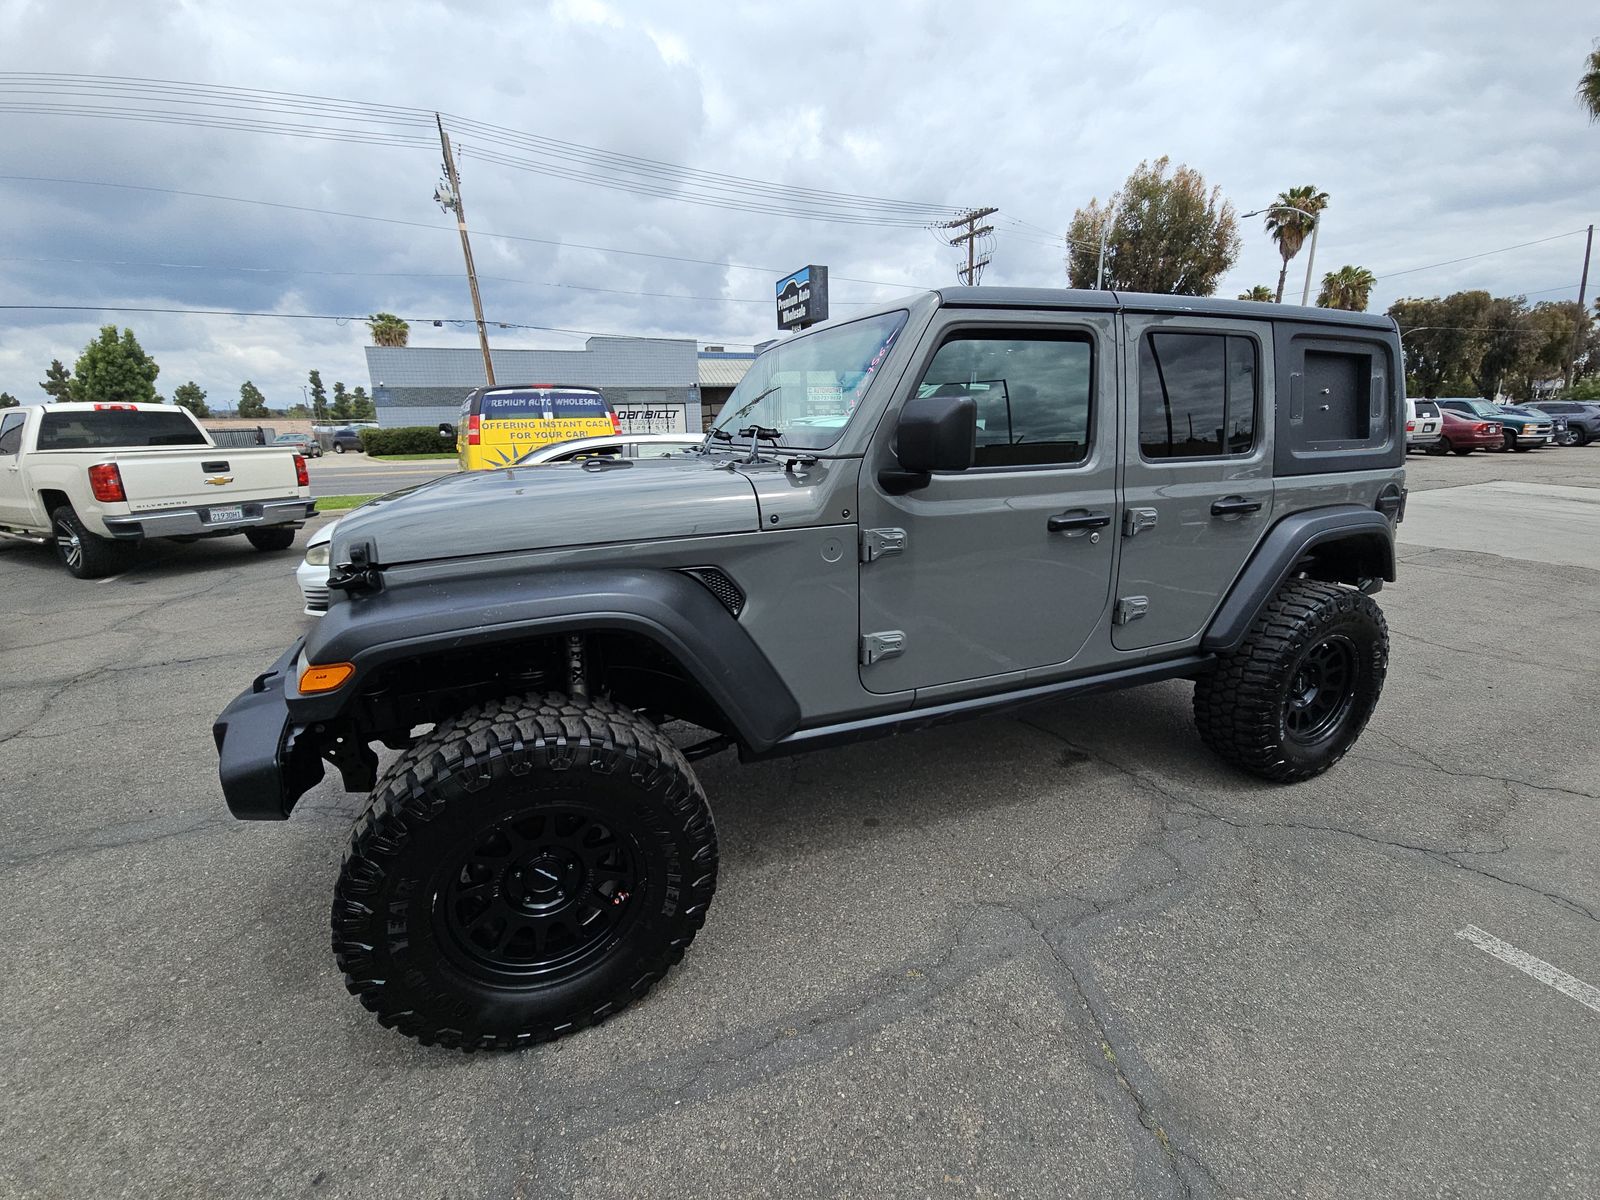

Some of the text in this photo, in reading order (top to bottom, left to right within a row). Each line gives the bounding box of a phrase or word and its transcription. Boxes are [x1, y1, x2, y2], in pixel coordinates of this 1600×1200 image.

[778, 288, 810, 311] Premium Auto
[783, 304, 806, 323] Wholesale
[528, 398, 552, 406] AUTO
[482, 420, 611, 430] OFFERING INSTANT CASH
[510, 430, 589, 440] FOR YOUR CAR!
[136, 500, 188, 508] SILVERADO
